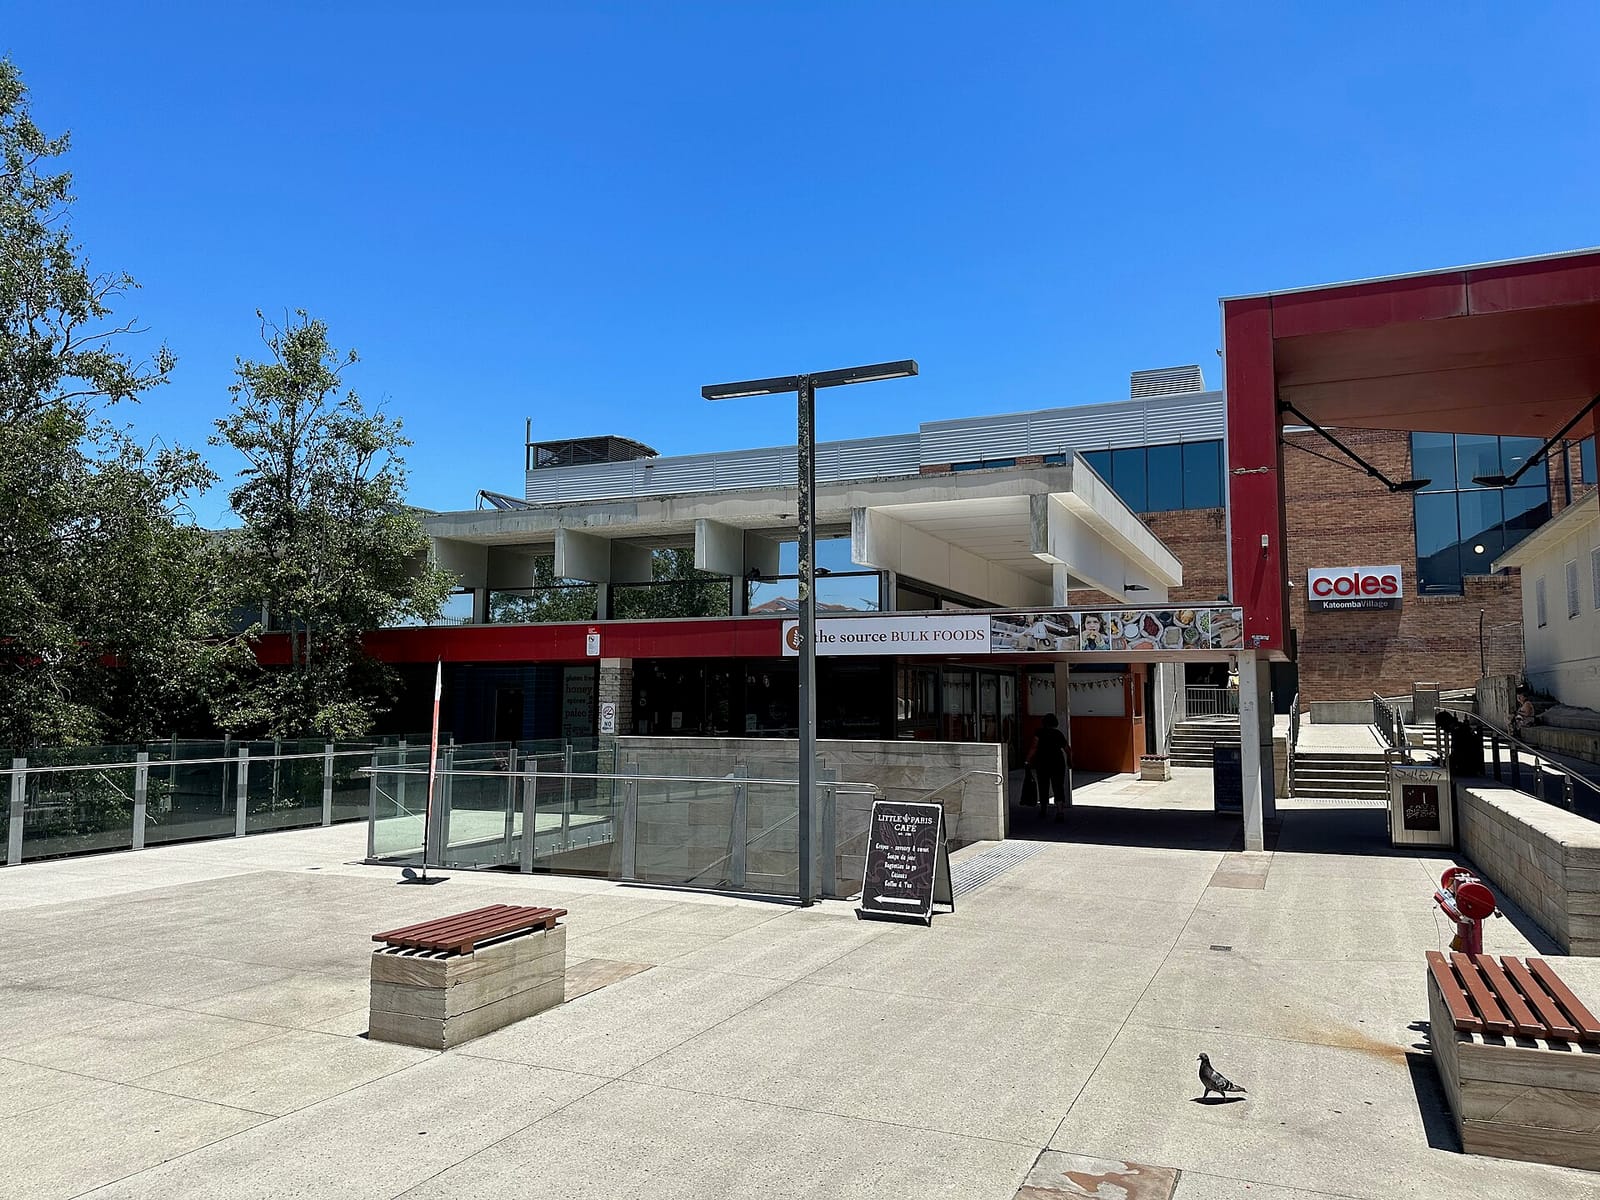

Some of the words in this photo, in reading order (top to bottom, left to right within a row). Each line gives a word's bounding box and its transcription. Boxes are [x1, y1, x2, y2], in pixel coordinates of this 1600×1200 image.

[1312, 572, 1398, 597] coles
[814, 629, 836, 644] the
[839, 632, 888, 643] source
[890, 630, 929, 642] BULK
[933, 629, 986, 642] FOODS
[567, 686, 592, 696] honey
[878, 814, 902, 822] LITTLE
